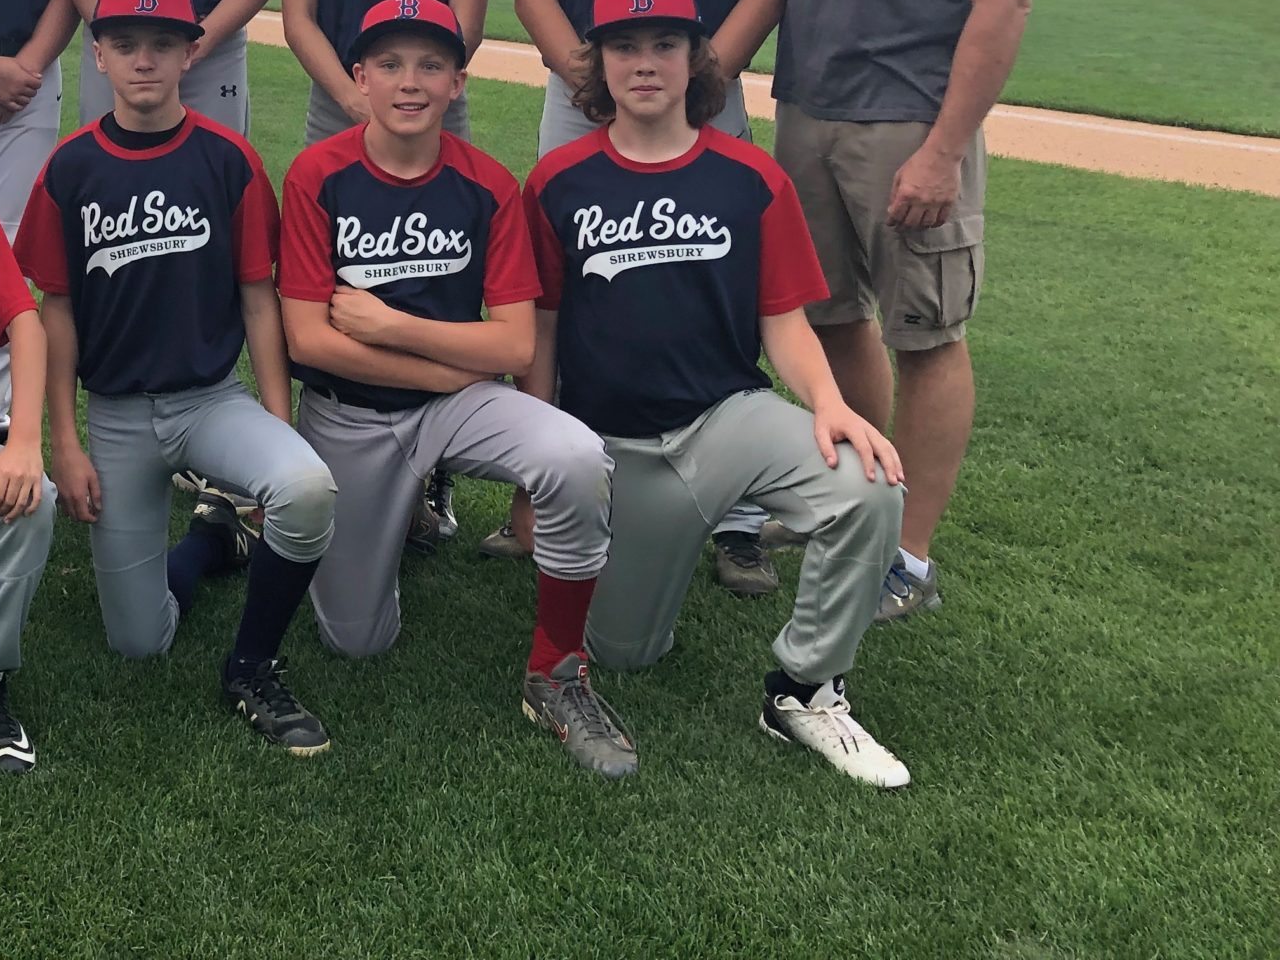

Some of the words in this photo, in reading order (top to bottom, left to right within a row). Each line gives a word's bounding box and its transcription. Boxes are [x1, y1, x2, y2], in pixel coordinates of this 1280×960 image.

[81, 196, 139, 247] Red
[142, 190, 201, 233] Sox
[336, 215, 401, 259] Red
[401, 211, 464, 256] Sox
[574, 200, 644, 250] Red
[649, 198, 722, 240] Sox
[110, 239, 187, 262] SHREWSBURY
[609, 246, 704, 265] SHREWSBURY
[364, 261, 451, 279] SHREWSBURY
